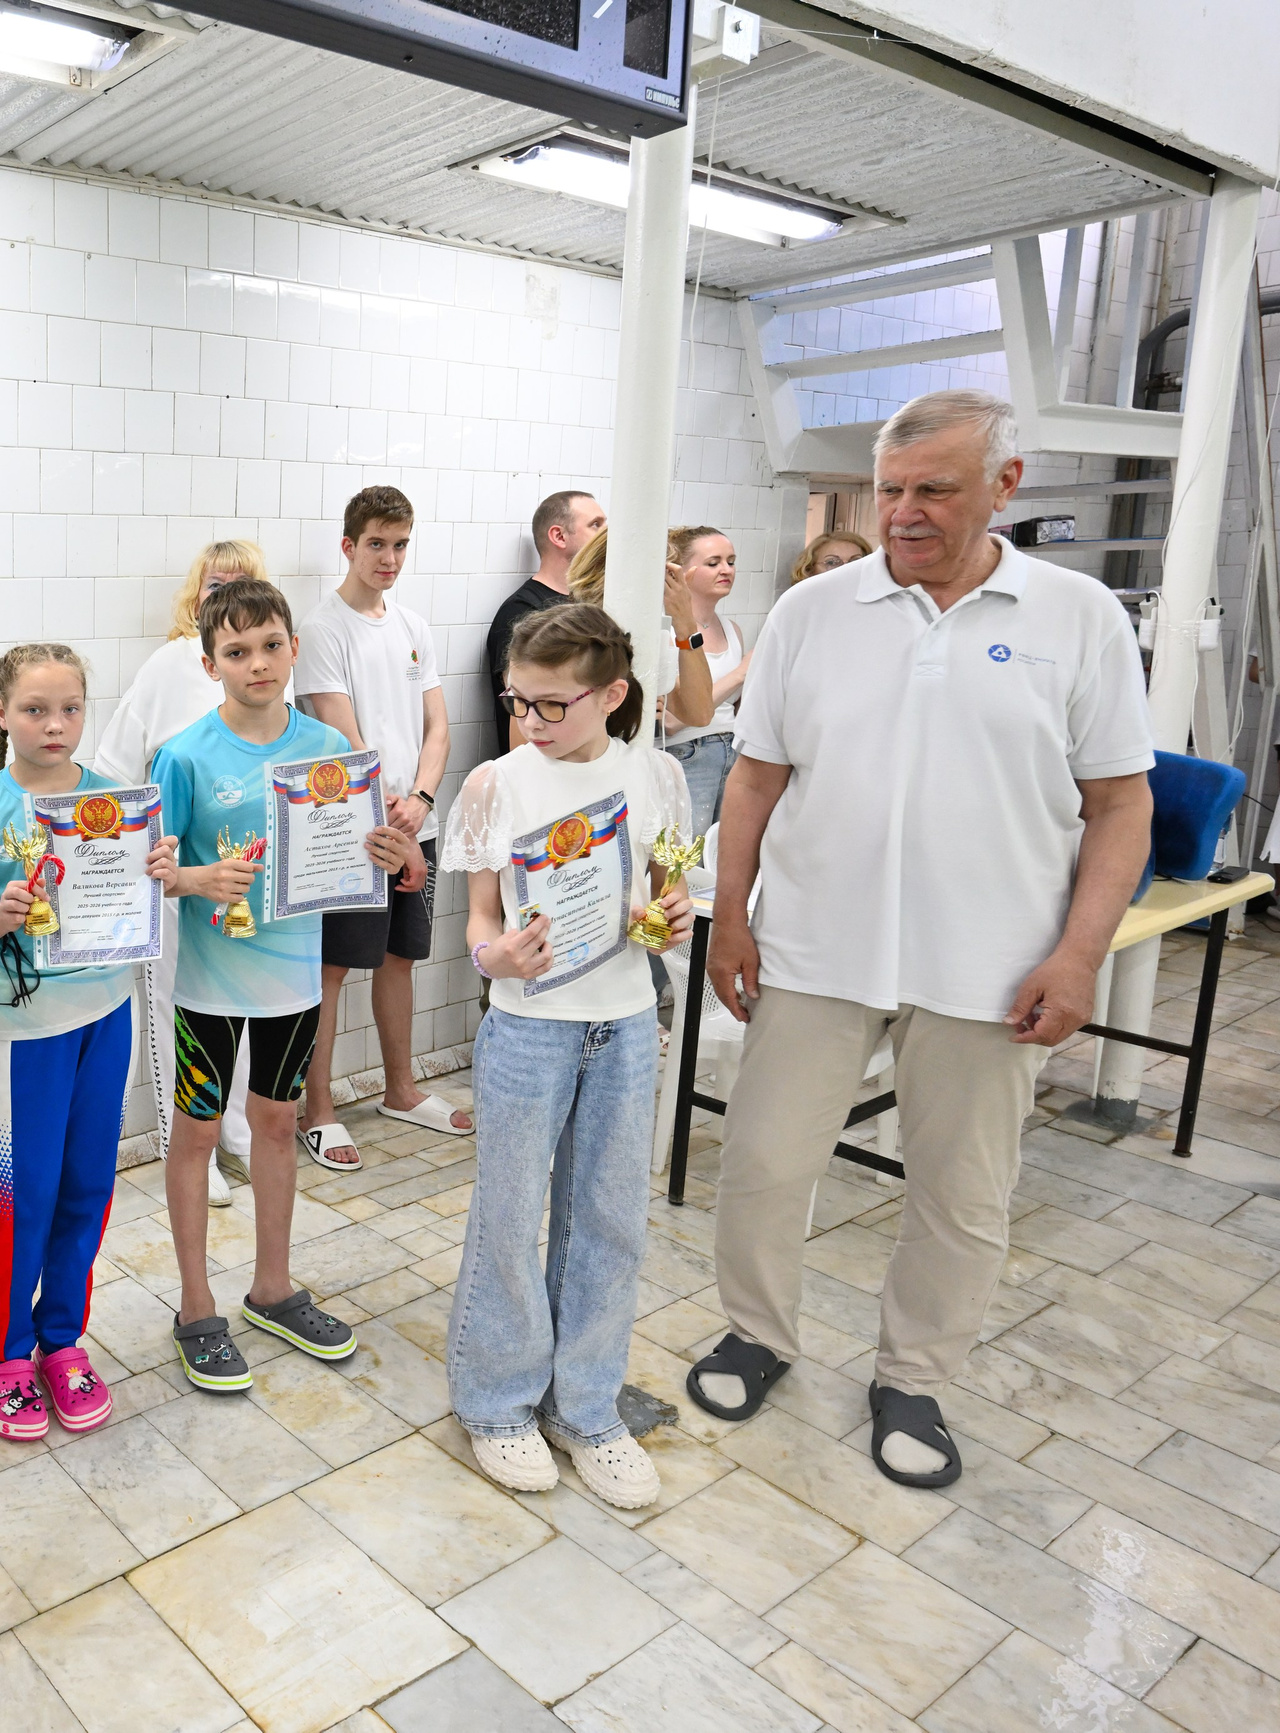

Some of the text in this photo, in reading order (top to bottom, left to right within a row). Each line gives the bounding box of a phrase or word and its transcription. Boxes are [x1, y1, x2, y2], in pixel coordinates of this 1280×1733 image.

[307, 809, 357, 829] Диплом
[312, 830, 352, 839] НАГРАЖДАЕТСЯ
[74, 843, 130, 864] Диплом
[81, 868, 125, 876] НАГРАЖДАЕТСЯ
[547, 866, 602, 890] Диплом
[556, 885, 598, 906] НАГРАЖДАЕТСЯ
